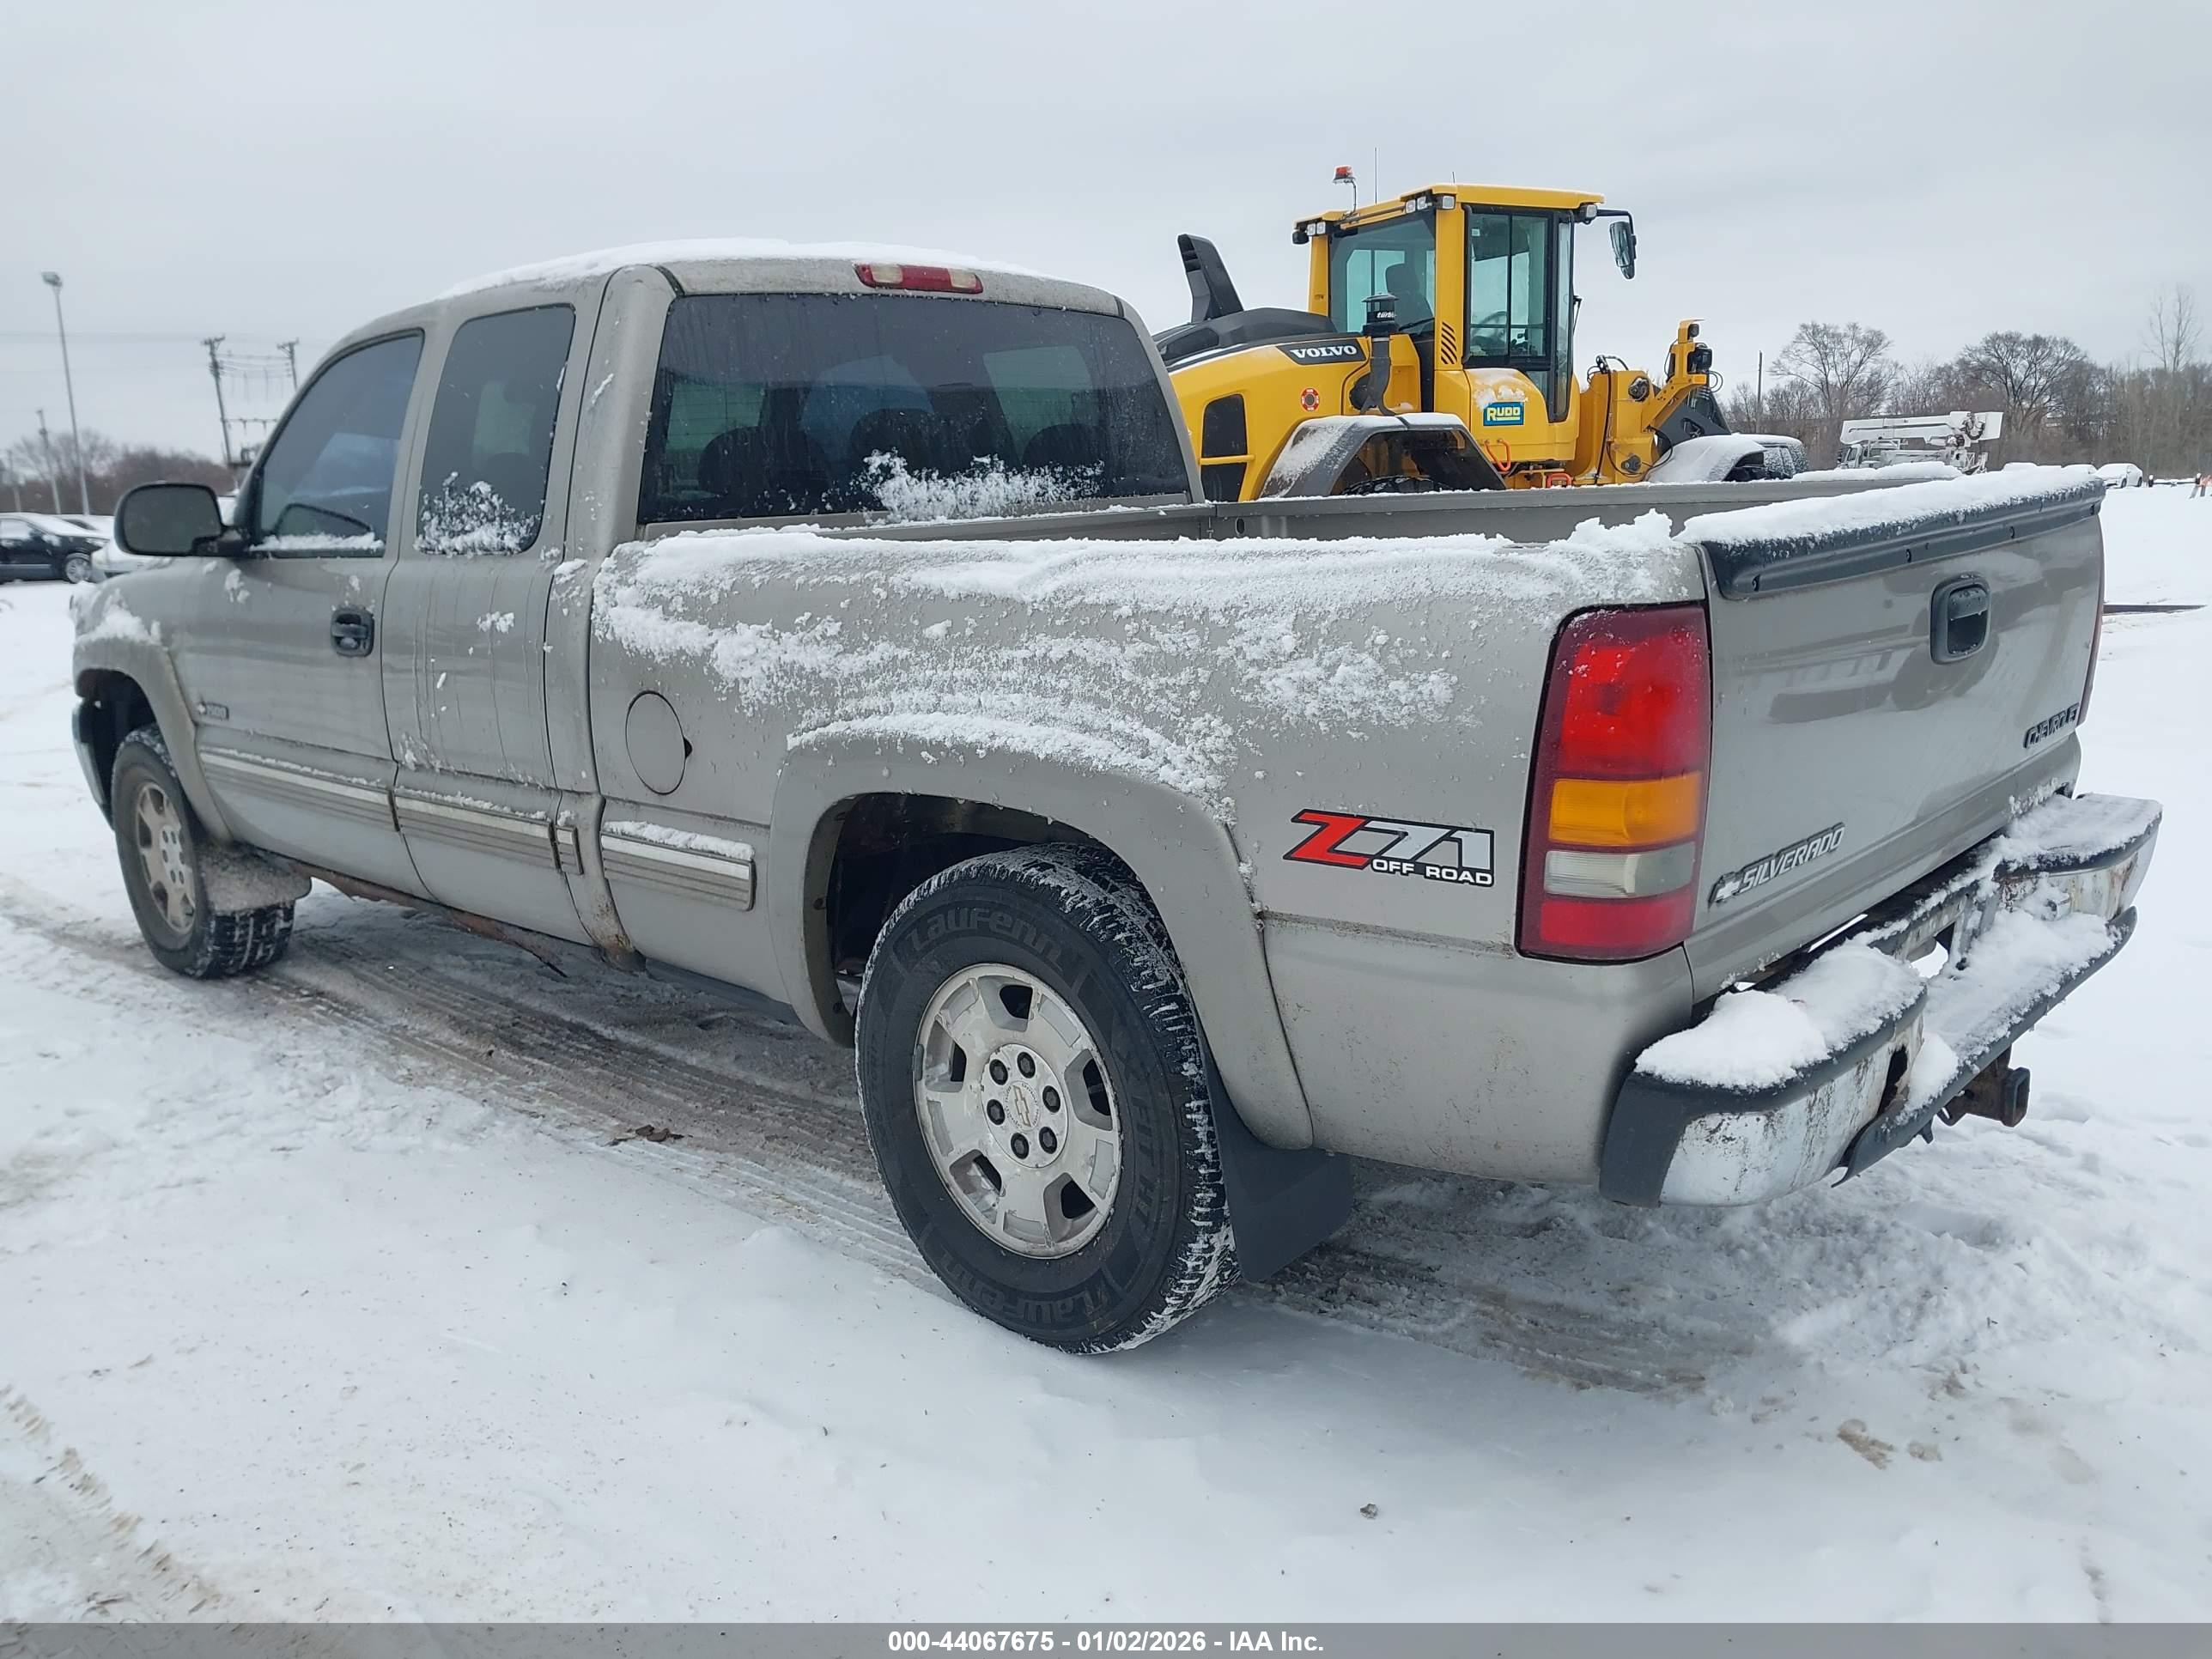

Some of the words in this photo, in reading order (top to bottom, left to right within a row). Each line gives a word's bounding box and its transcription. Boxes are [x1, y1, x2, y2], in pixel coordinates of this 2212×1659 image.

[1290, 345, 1357, 358] VOLVO
[1486, 407, 1521, 422] RUDD
[1283, 809, 1494, 869] Z71
[1373, 859, 1415, 874] OFF
[1425, 866, 1492, 885] ROAD
[1739, 825, 1845, 894] SILVERADO
